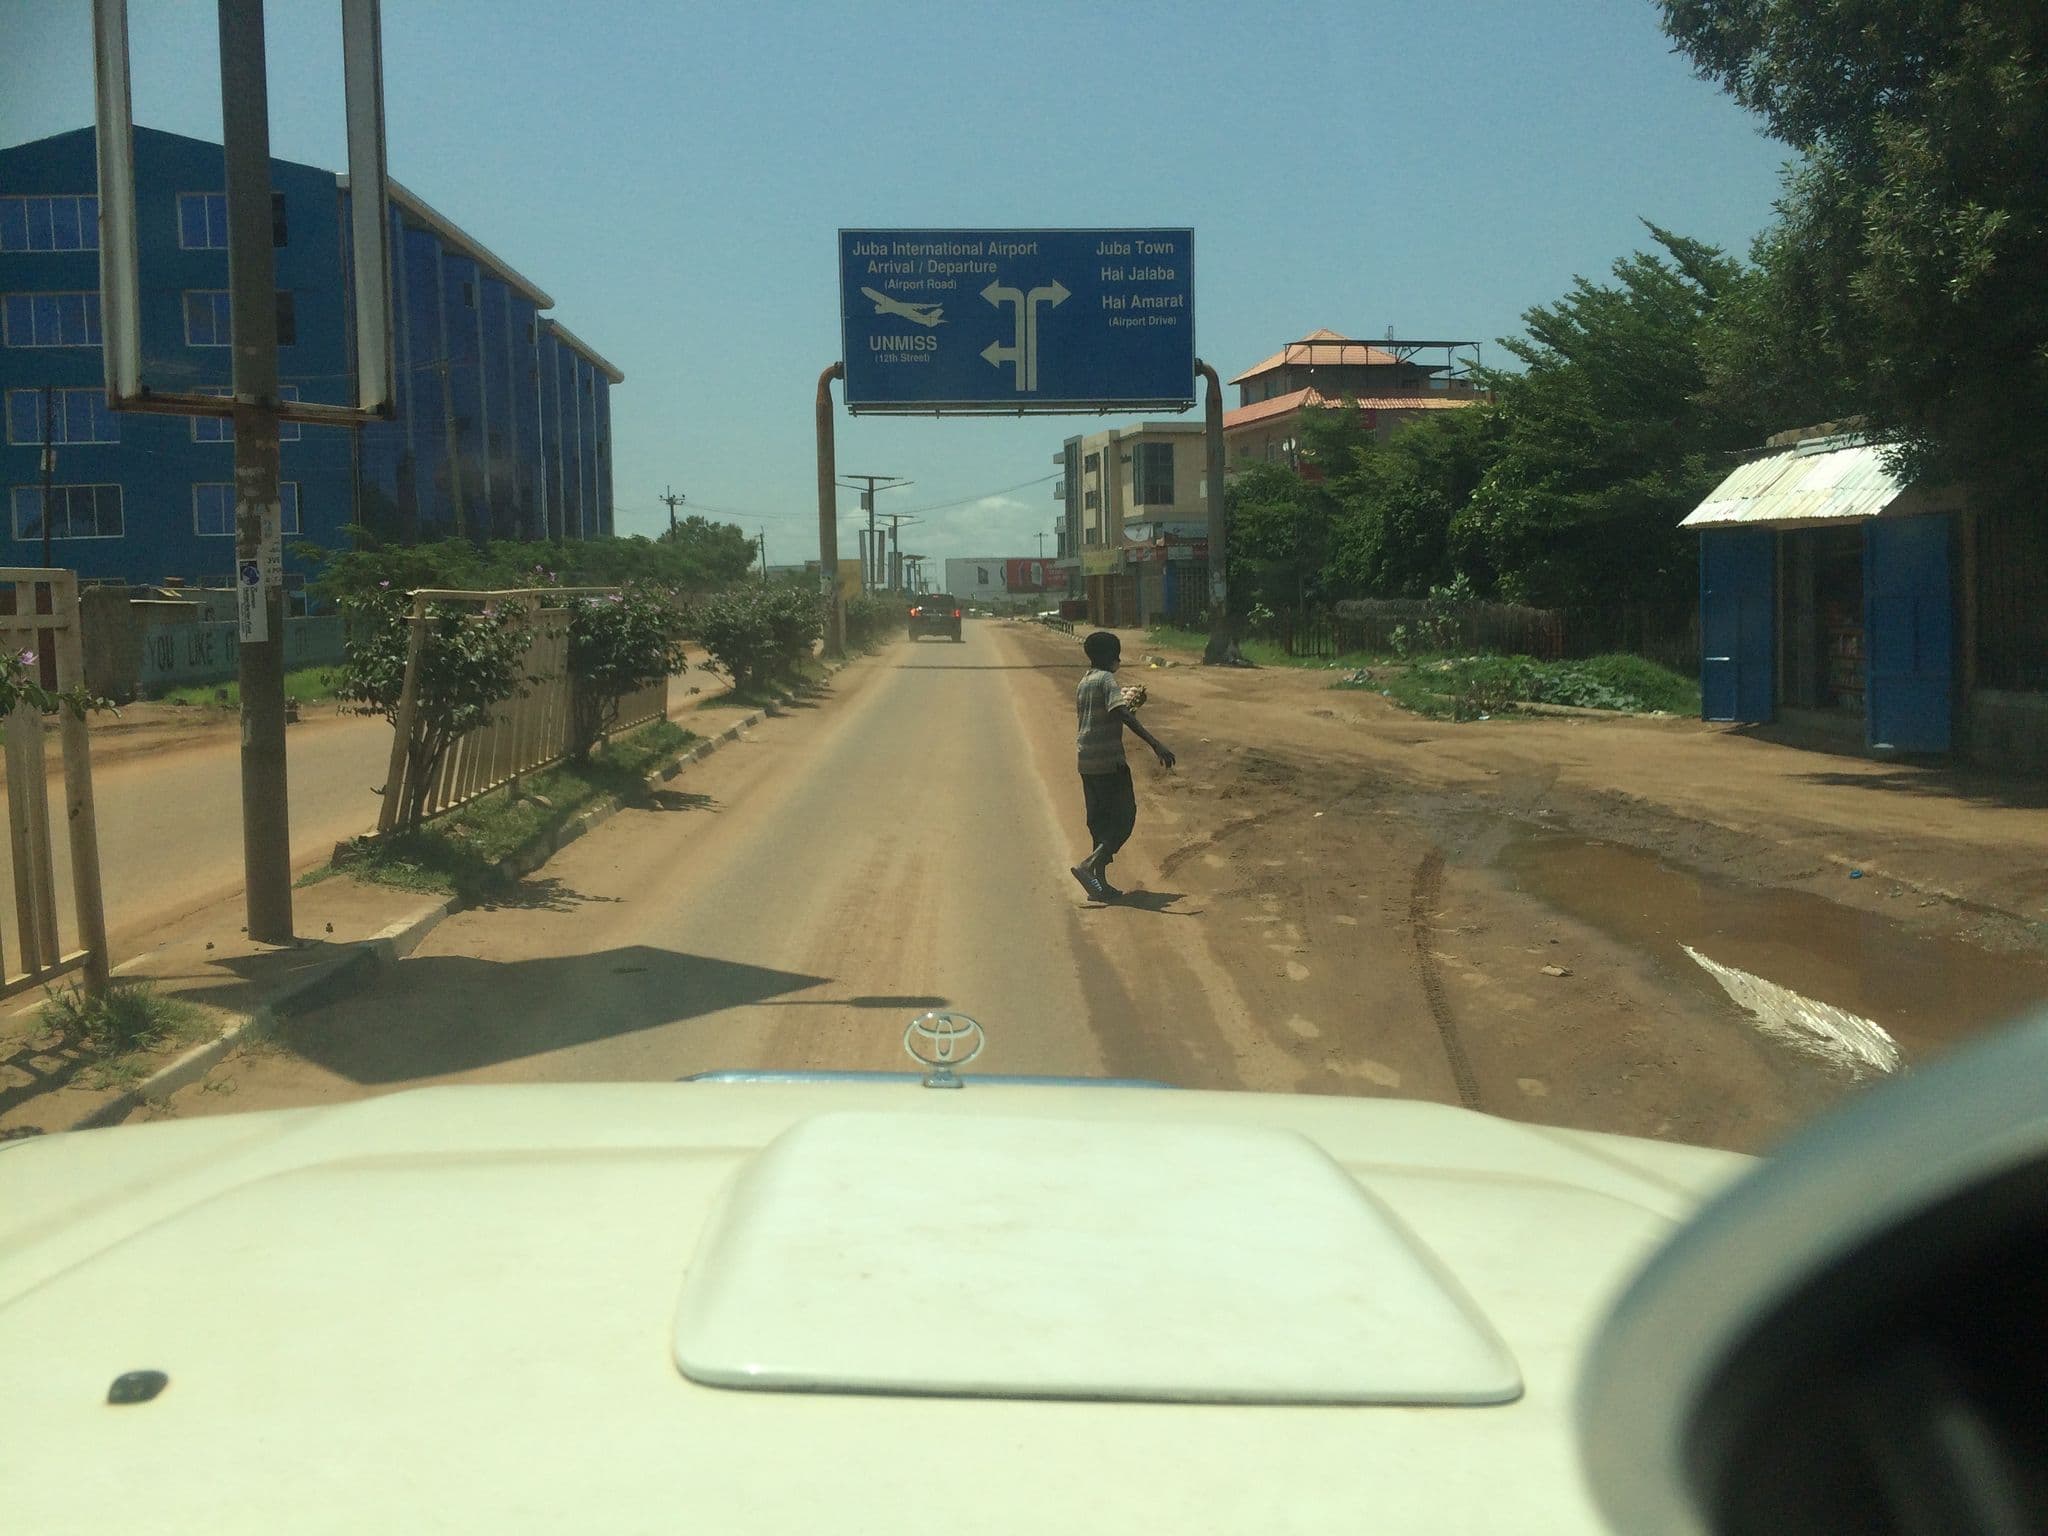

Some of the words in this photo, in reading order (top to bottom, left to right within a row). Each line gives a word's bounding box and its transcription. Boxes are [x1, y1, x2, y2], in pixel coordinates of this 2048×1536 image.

[852, 241, 888, 256] Juba
[893, 241, 983, 256] International
[988, 241, 1039, 258] Airport
[1096, 241, 1131, 256] Juba
[1135, 240, 1174, 255] Town
[868, 260, 914, 274] Arrival
[928, 260, 998, 276] Departure
[1101, 266, 1124, 281] Hai
[1128, 266, 1175, 281] Jalaba
[884, 279, 924, 291] (Airport
[927, 279, 957, 290] Road)
[1102, 295, 1126, 309] Hai
[1130, 294, 1184, 309] Amarat
[1108, 317, 1146, 328] (Airport
[1148, 316, 1177, 326] Drive)
[869, 335, 938, 351] UNMISS
[875, 353, 898, 363] (12th
[900, 353, 930, 363] Street)
